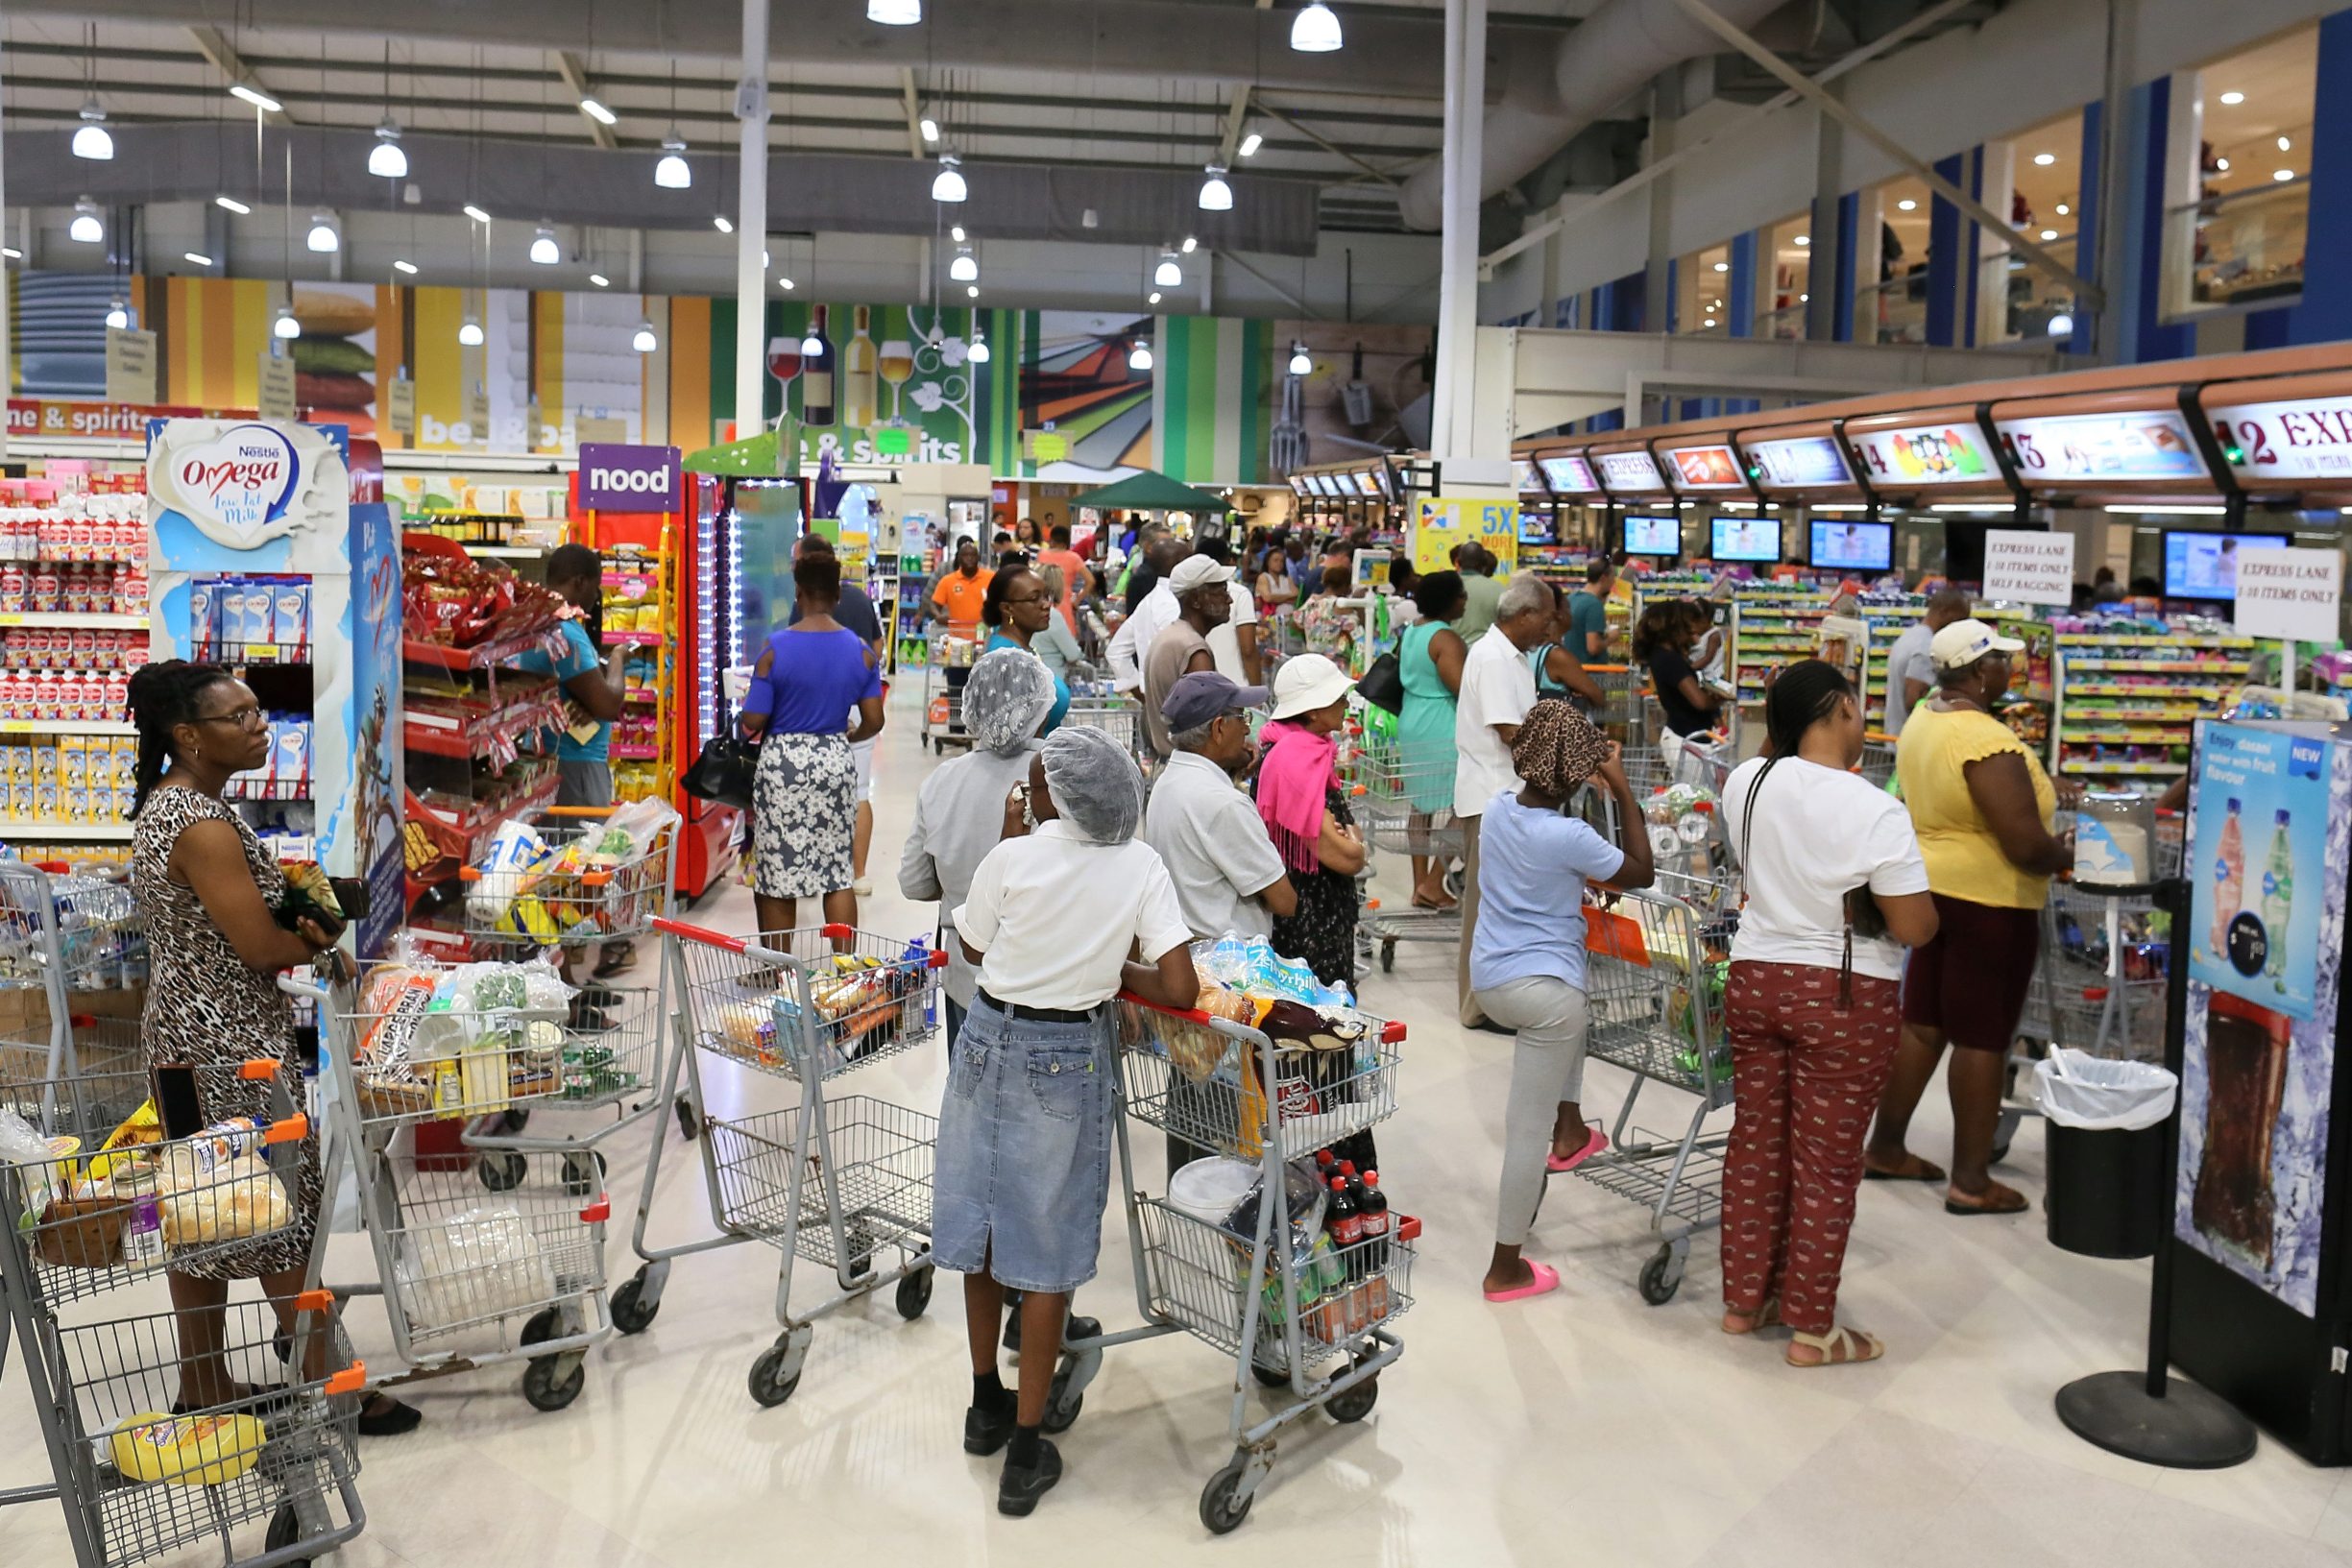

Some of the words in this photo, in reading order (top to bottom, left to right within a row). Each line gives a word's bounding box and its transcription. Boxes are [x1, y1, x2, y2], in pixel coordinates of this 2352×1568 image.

[46, 406, 65, 429] &
[818, 433, 846, 462] &
[854, 432, 961, 464] sits
[2017, 434, 2045, 469] 3
[2238, 421, 2277, 464] 2
[1869, 445, 1888, 473] 4
[183, 460, 279, 499] Omega
[591, 465, 669, 494] nood
[225, 509, 257, 523] Milk
[1483, 506, 1515, 535] 5X
[1481, 535, 1515, 548] MORE
[2037, 545, 2066, 555] LANE
[2040, 564, 2069, 574] ONLY
[2296, 567, 2331, 580] LANE
[2300, 590, 2334, 603] ONLY
[2210, 732, 2236, 750] Enjoy
[2292, 746, 2321, 763] NEW
[2206, 764, 2245, 785] flavour
[2253, 757, 2276, 775] fruit
[397, 989, 422, 1014] BRAN
